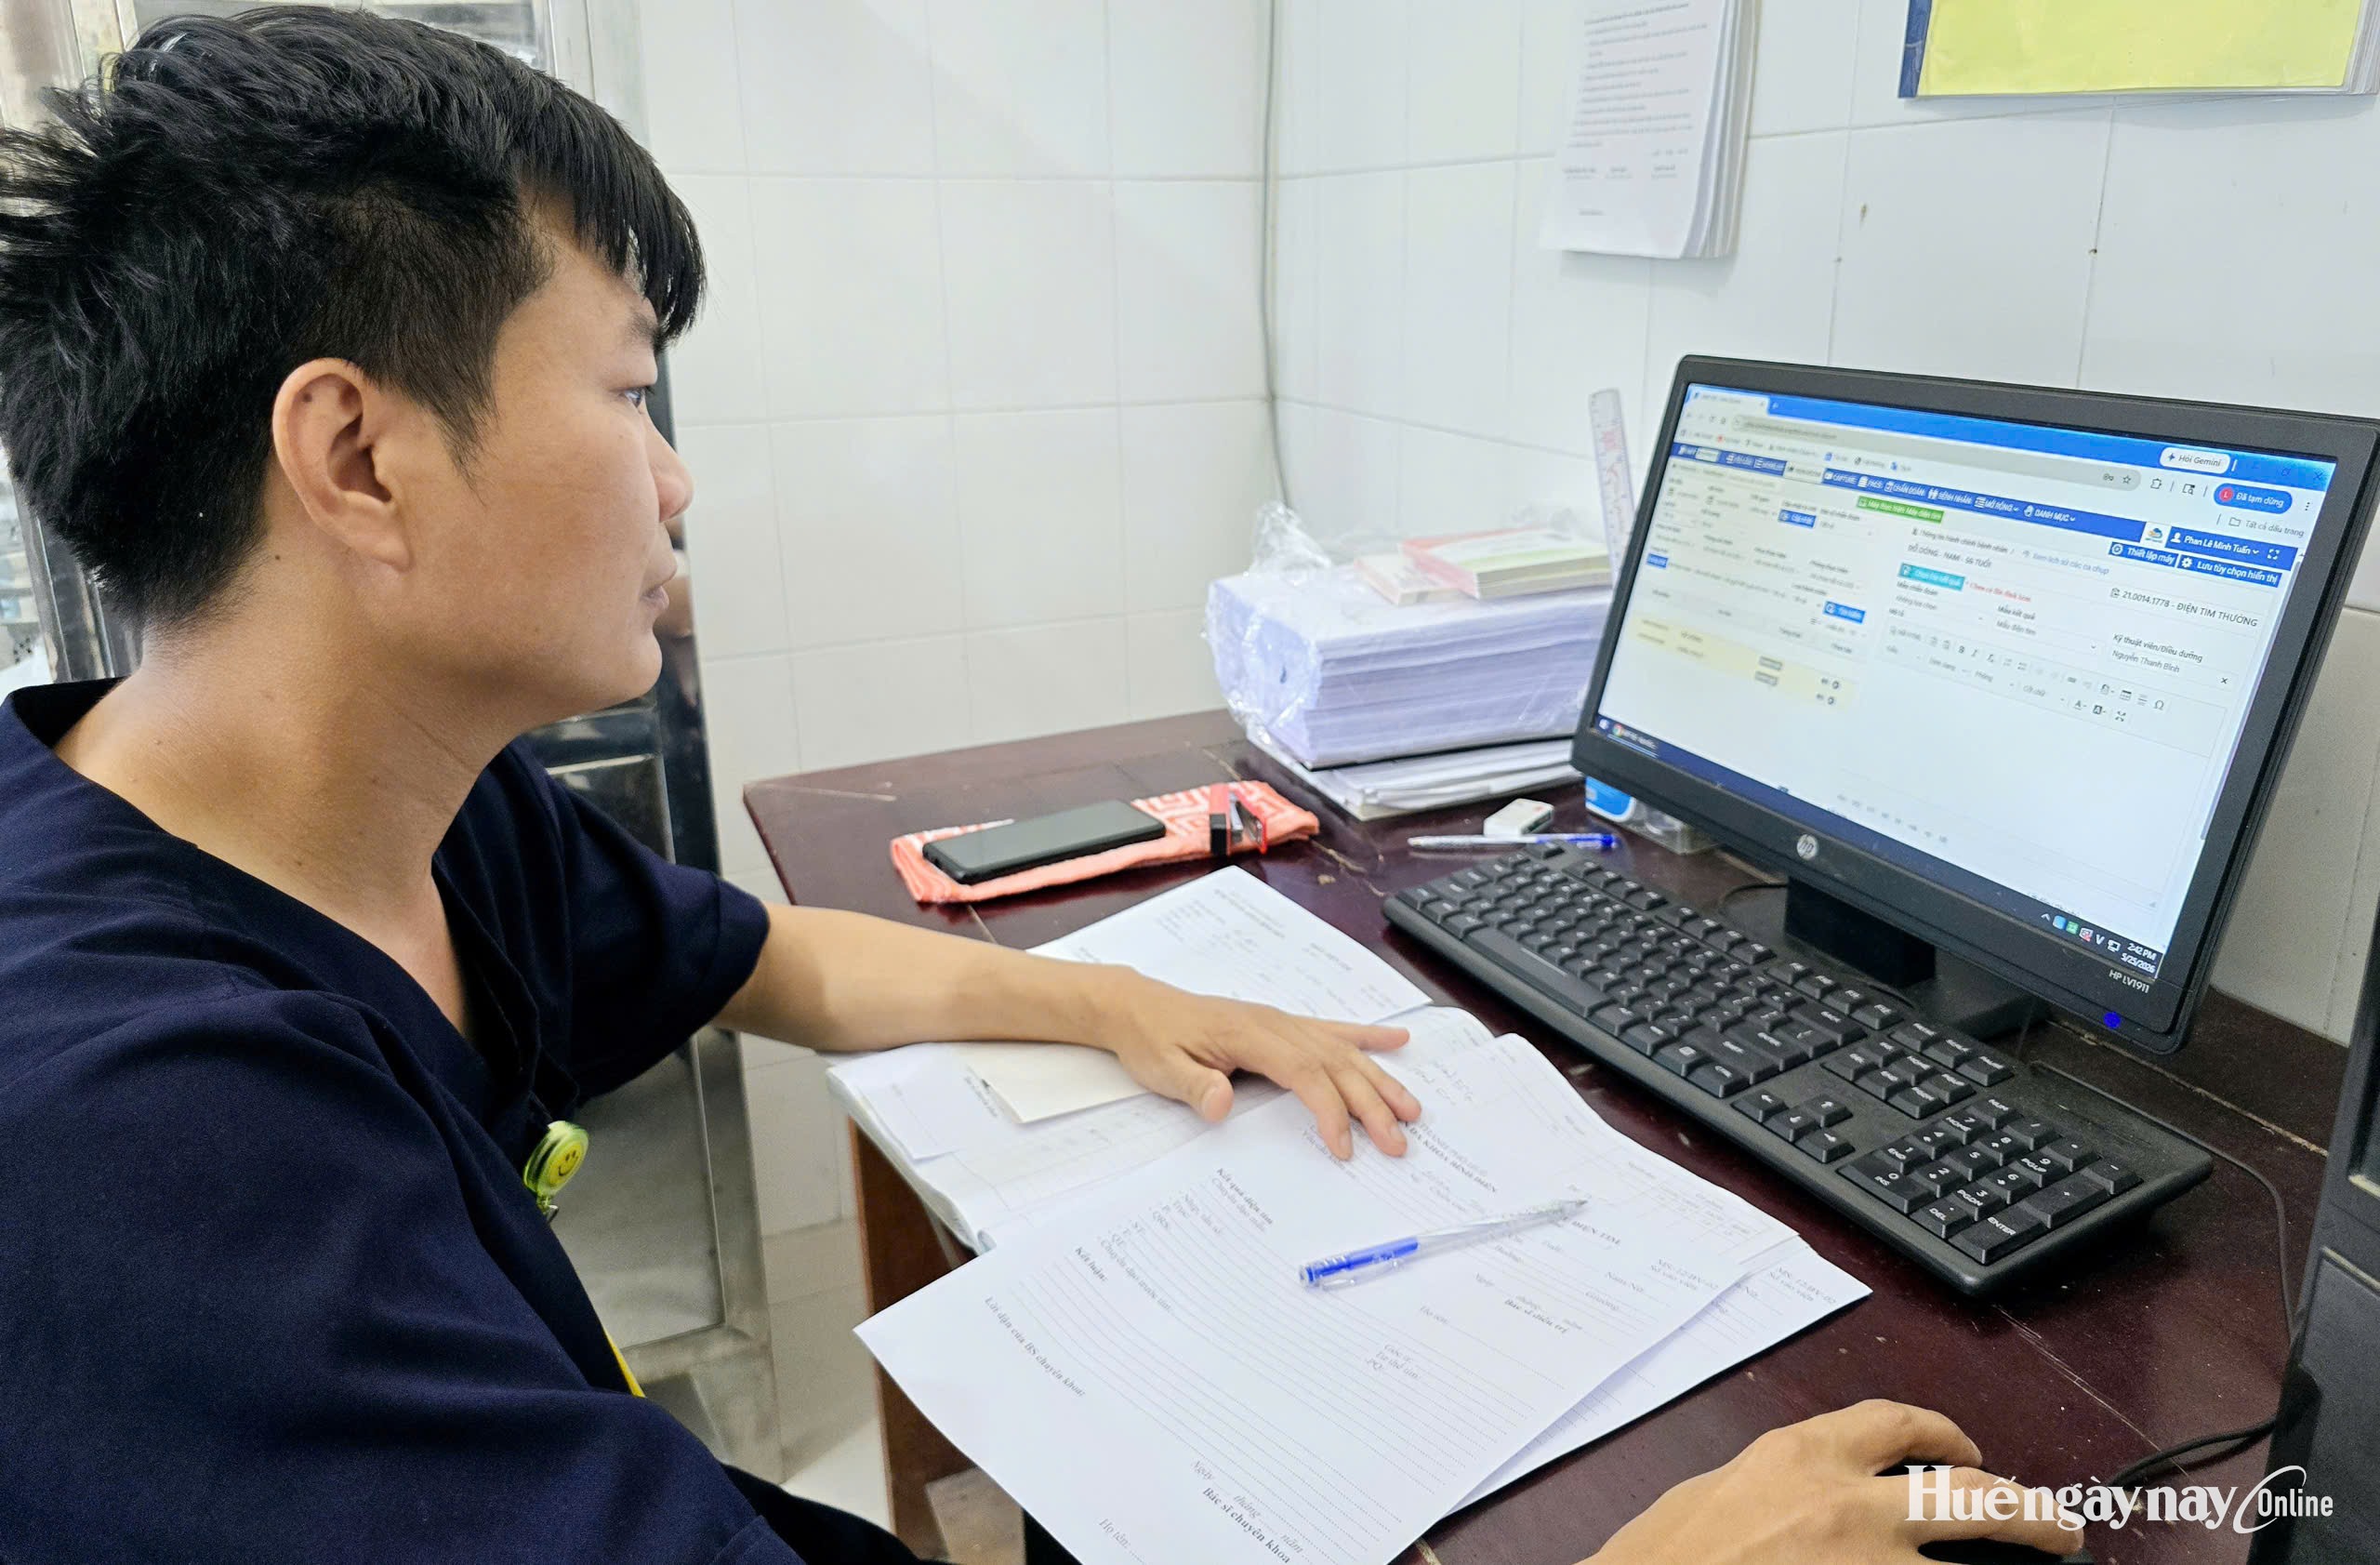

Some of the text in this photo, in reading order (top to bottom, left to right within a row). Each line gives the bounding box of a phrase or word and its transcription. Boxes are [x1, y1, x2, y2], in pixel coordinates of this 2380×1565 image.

[2178, 455, 2222, 468] Hỏi Gemini
[2236, 491, 2284, 509] Đã tạm dừng
[2284, 527, 2304, 537] trang
[2184, 535, 2251, 555] Phan Lê Minh Tuấn
[2127, 546, 2175, 565] Thiết lập máy
[2197, 561, 2278, 584] Lưu tùy chọn hiển thị
[2122, 590, 2170, 608] 21.0014.1778
[2176, 602, 2198, 616] ĐIỆN
[2200, 606, 2215, 618] TIM
[2217, 610, 2258, 628] THƯỜNG
[2113, 633, 2122, 643] Kỹ
[2122, 635, 2142, 648] thuật
[2178, 648, 2203, 664] dưỡng
[2140, 656, 2162, 670] Thanh
[2142, 948, 2157, 961] PM
[2121, 953, 2157, 974] 5/25/2026
[2109, 969, 2150, 994] HP LV1911
[1945, 1116, 1971, 1132] HOME
[1887, 1147, 1906, 1160] END
[1937, 1167, 1950, 1175] 2
[2020, 1158, 2047, 1173] PGUP
[1874, 1175, 1890, 1187] INS
[1957, 1188, 1984, 1207] PGDN
[1977, 1189, 1988, 1198] 3
[1929, 1207, 1947, 1221] DEL
[1988, 1216, 2016, 1236] ENTER
[1098, 1518, 1115, 1534] Họ
[1202, 1487, 1290, 1564] Bác sĩ chuyên khoa
[1233, 1494, 1262, 1520] tháng
[1279, 1533, 1304, 1554] năm
